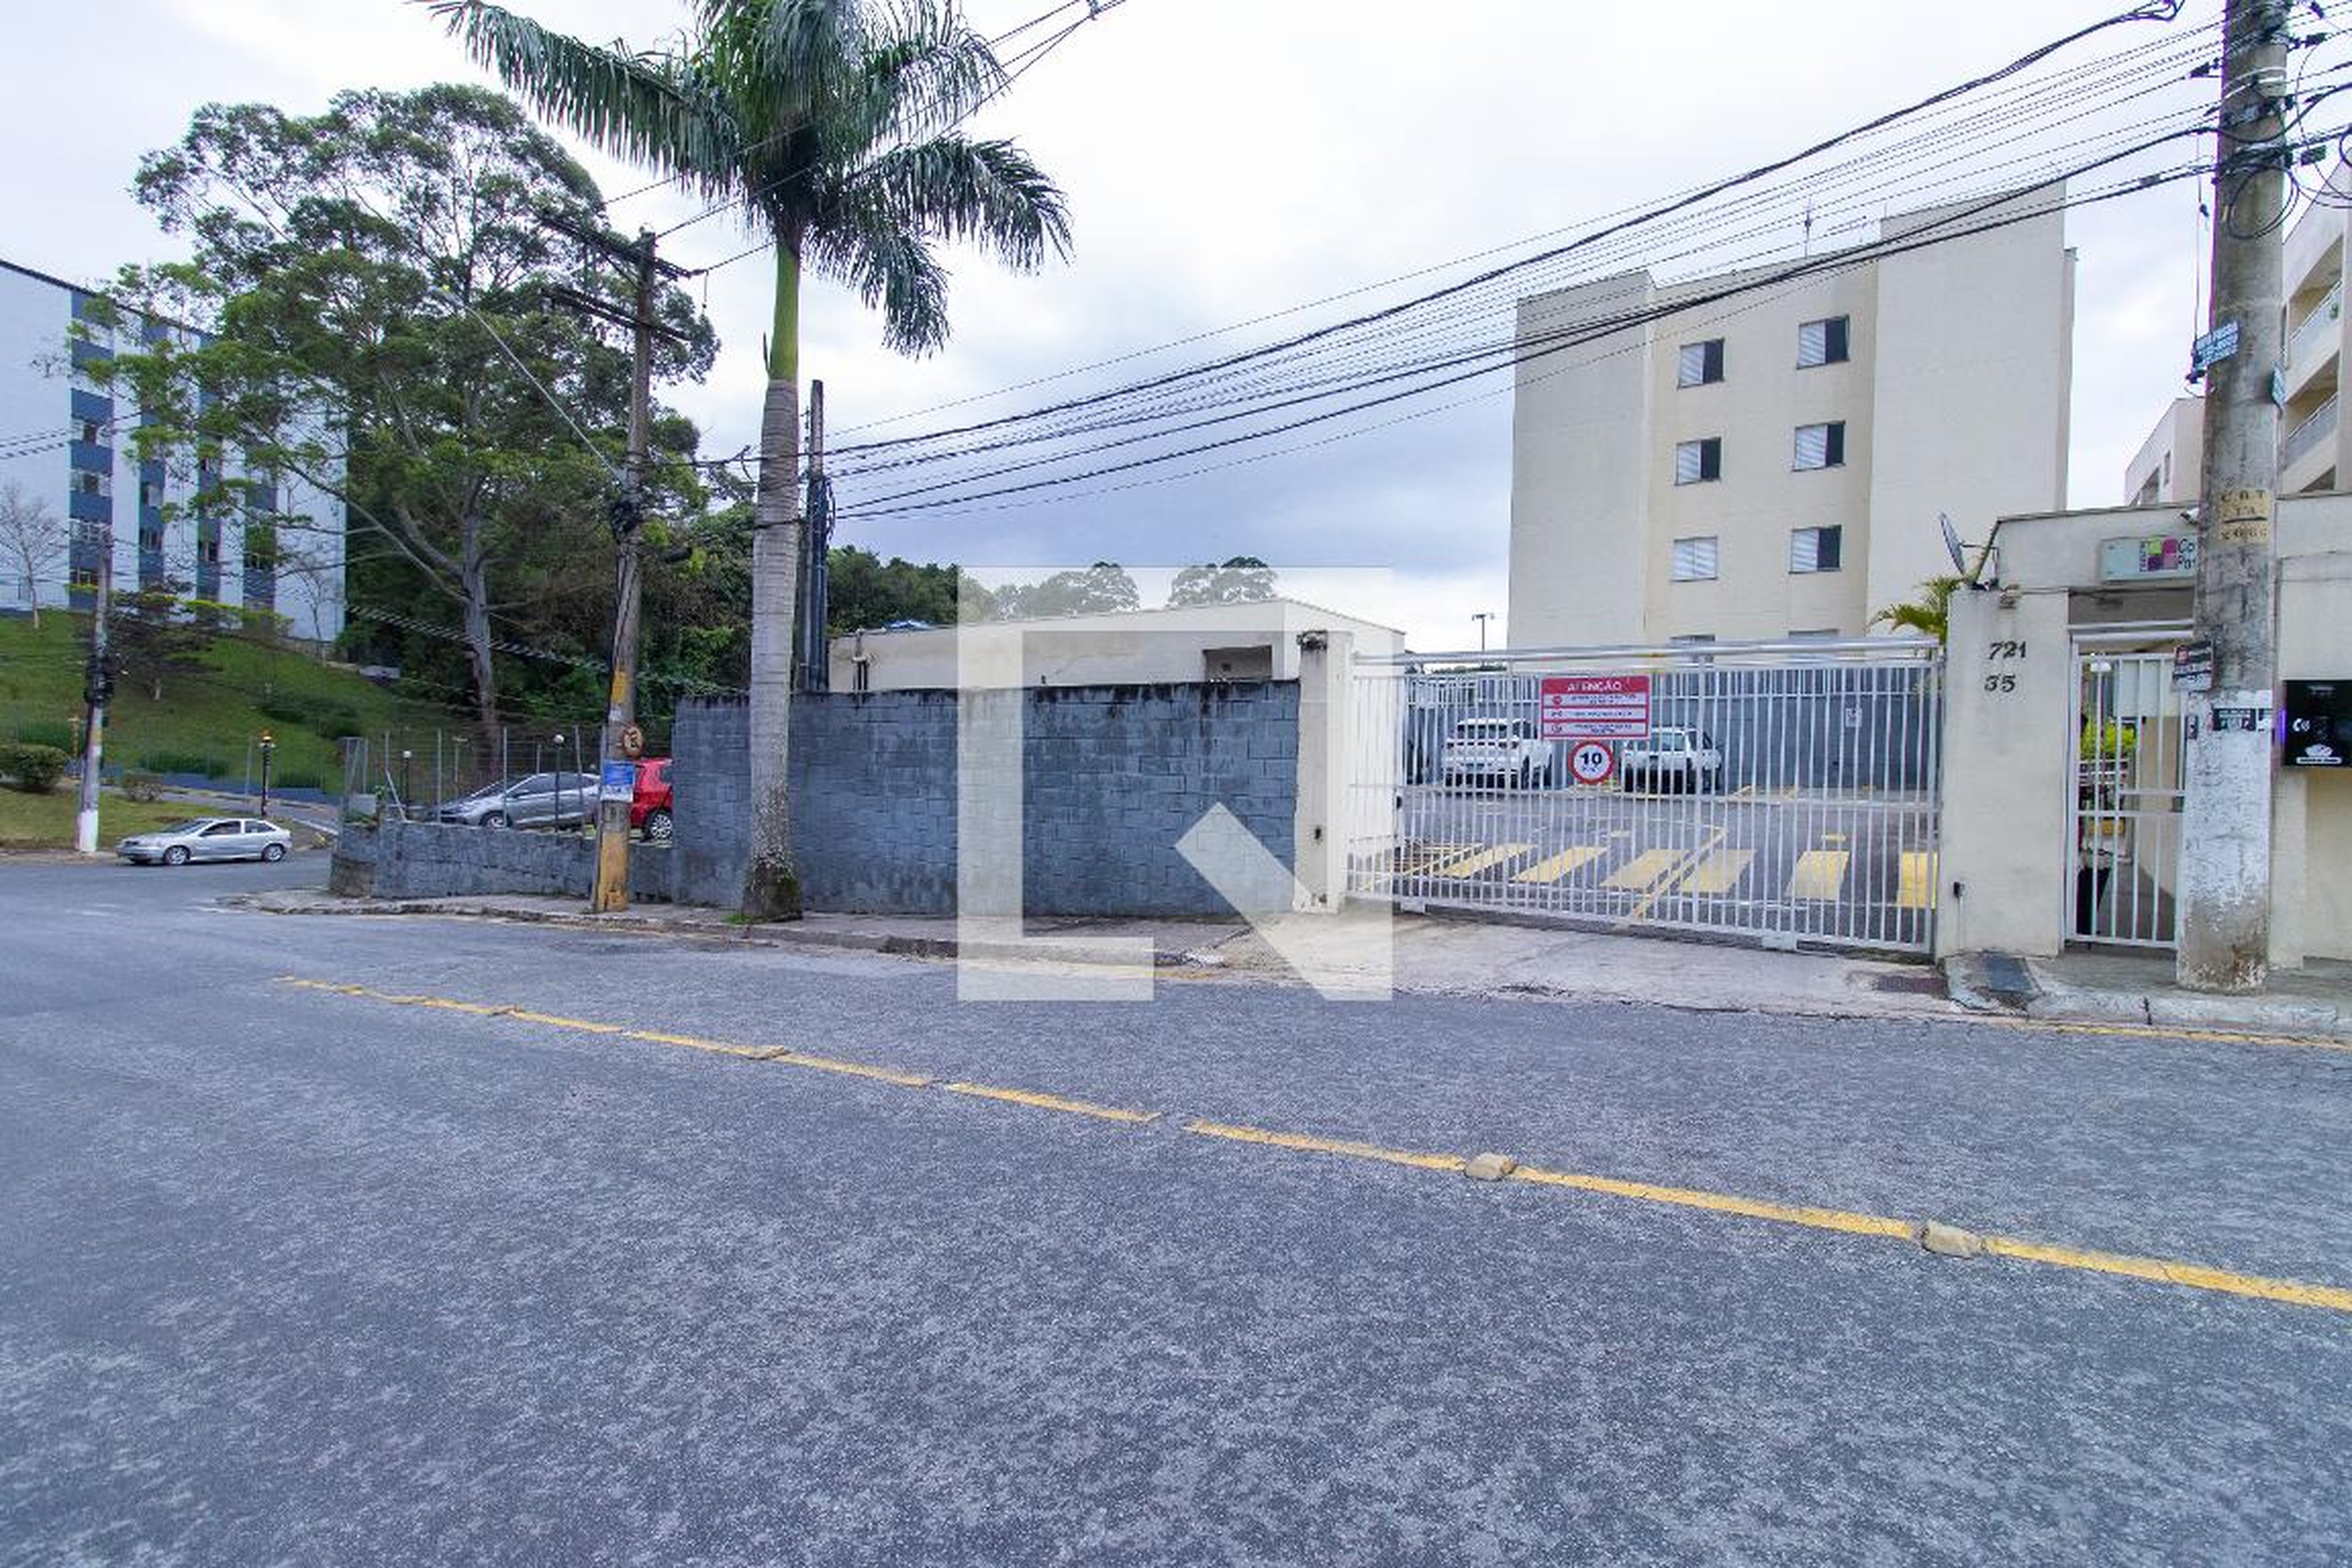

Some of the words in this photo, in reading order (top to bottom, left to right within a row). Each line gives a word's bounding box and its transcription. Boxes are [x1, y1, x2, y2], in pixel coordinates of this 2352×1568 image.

[1988, 640, 2027, 660] 721
[1984, 674, 2016, 693] 35
[1580, 752, 1602, 765] 10
